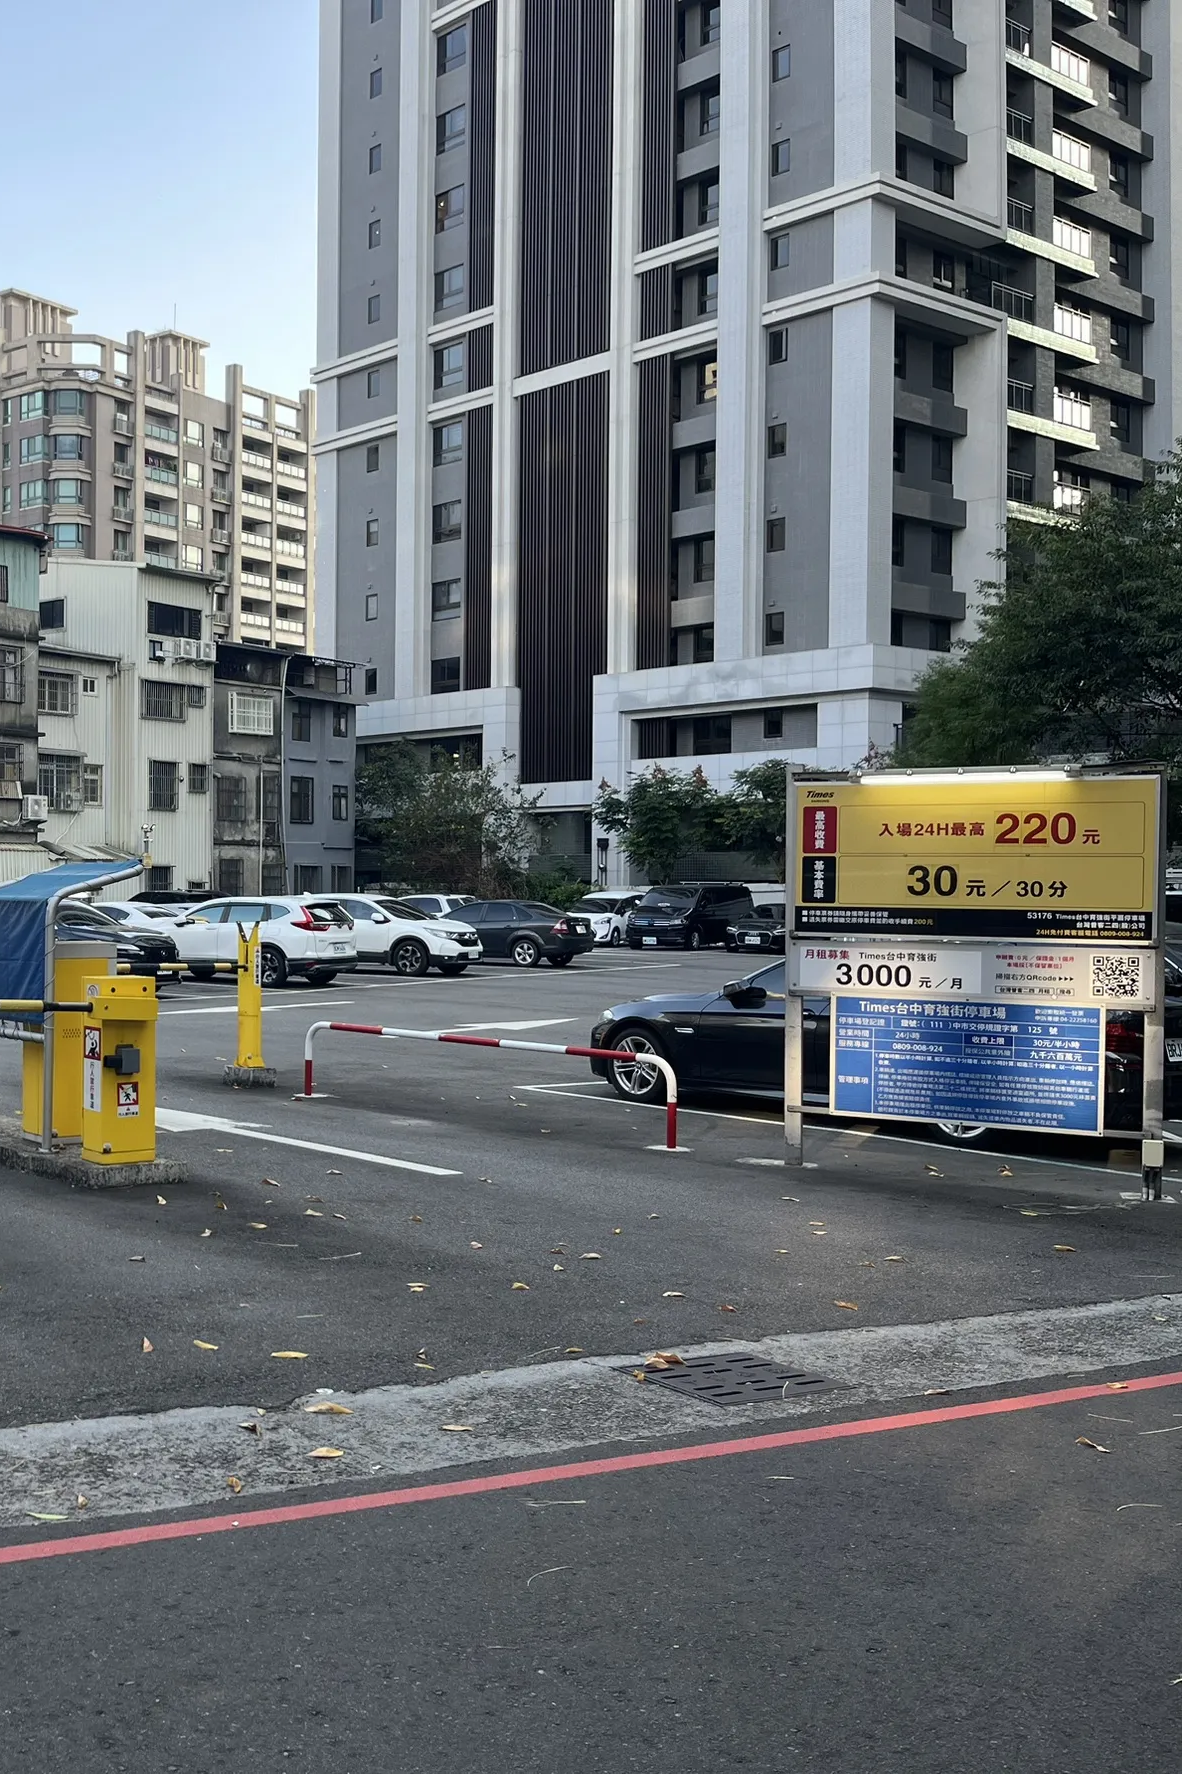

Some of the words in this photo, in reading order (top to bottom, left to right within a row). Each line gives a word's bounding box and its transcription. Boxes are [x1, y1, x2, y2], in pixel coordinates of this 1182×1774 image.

[806, 791, 835, 799] Times
[814, 811, 826, 850] 最高收費
[879, 822, 985, 837] 入場24H最高
[995, 812, 1077, 845] 220
[1082, 829, 1101, 844] 元
[813, 860, 825, 899] 基本費率
[907, 865, 958, 897] 30
[1027, 912, 1053, 920] 53176
[804, 949, 850, 960] 月租募集
[859, 952, 937, 963] Times台中育強街
[835, 963, 912, 988] 3,000
[859, 1001, 1007, 1020] Times台中育強街停車場
[838, 1017, 885, 1027] 停車場登記證
[838, 1028, 870, 1038] 營業時間
[1028, 1026, 1042, 1034] 125
[895, 1031, 920, 1040] 24小時
[971, 1036, 1005, 1045] 收費上限
[892, 1043, 943, 1052] 0809-008-924
[1166, 1041, 1182, 1059] BRJ
[1029, 1051, 1083, 1062] 九千六百萬元
[837, 1075, 869, 1085] 管理事項
